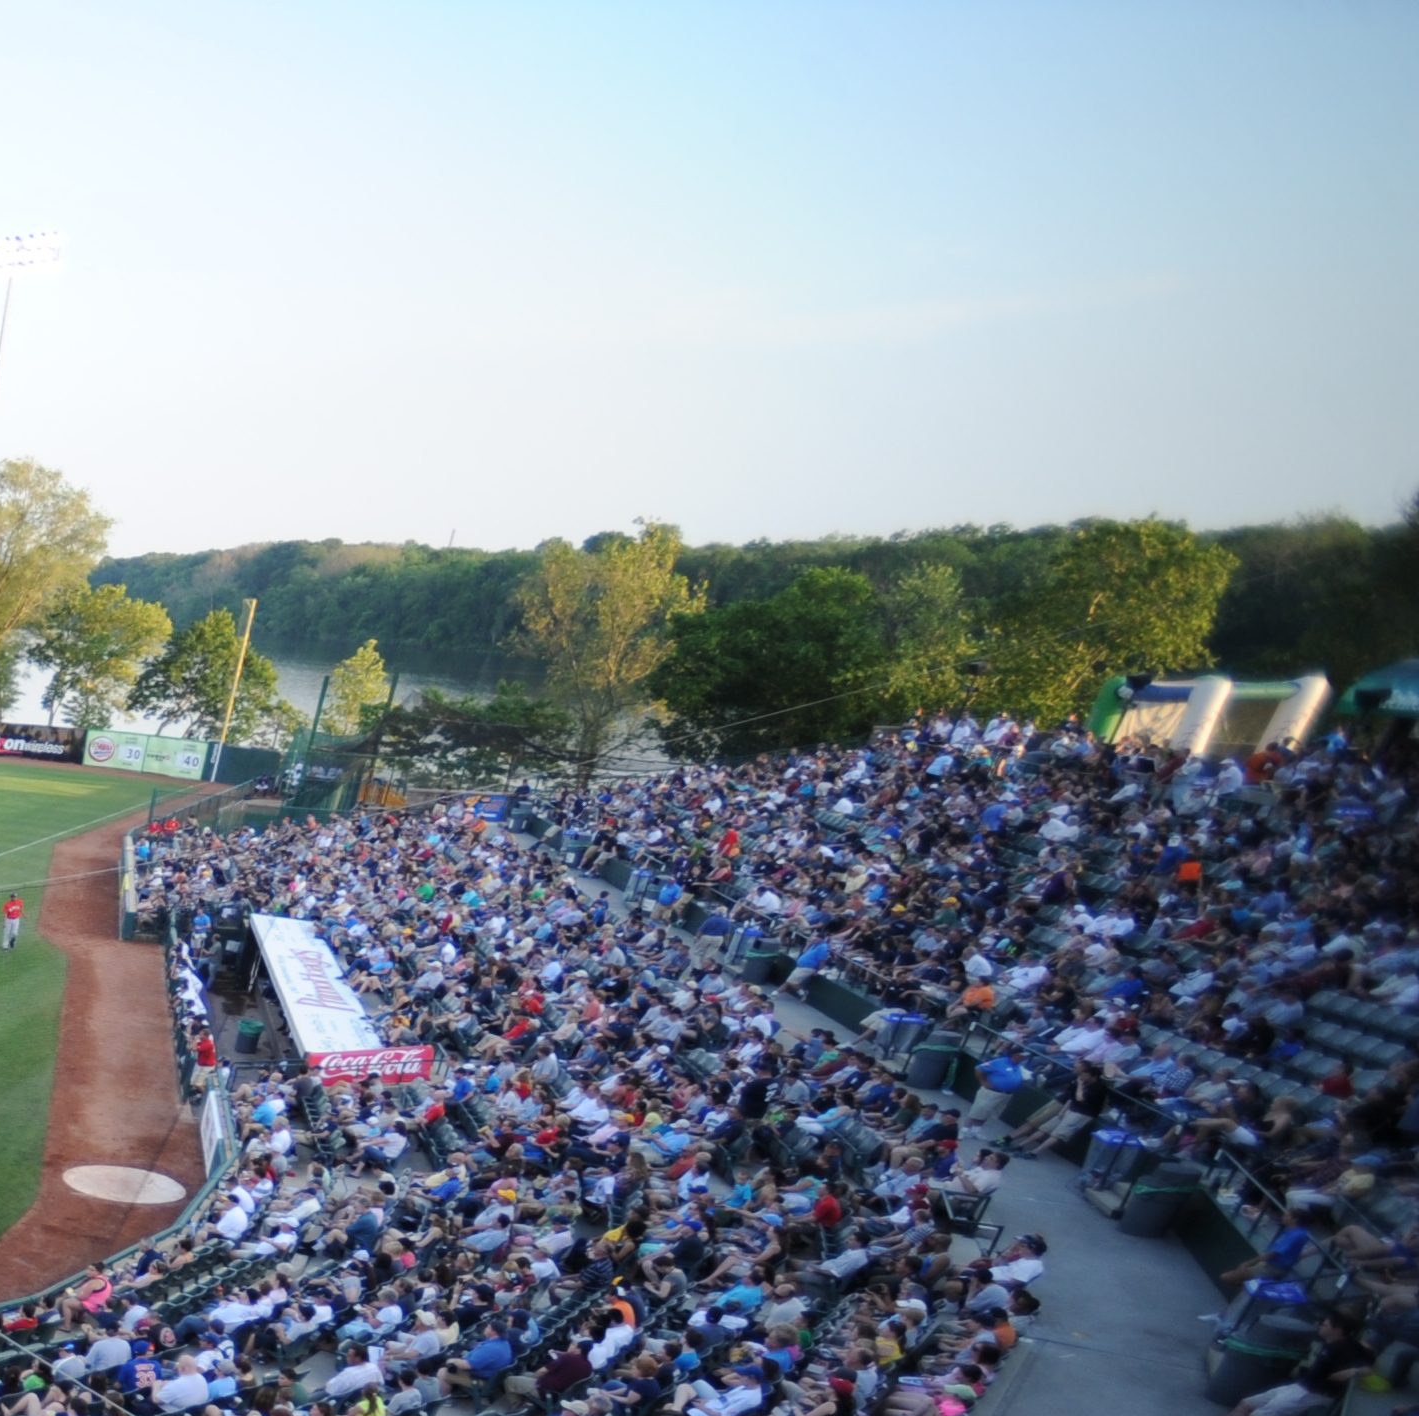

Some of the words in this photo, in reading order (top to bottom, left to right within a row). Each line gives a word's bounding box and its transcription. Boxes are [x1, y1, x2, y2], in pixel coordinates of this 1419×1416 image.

[126, 748, 140, 759] 30
[184, 755, 199, 767] 40
[320, 1049, 425, 1079] Coca-Cola
